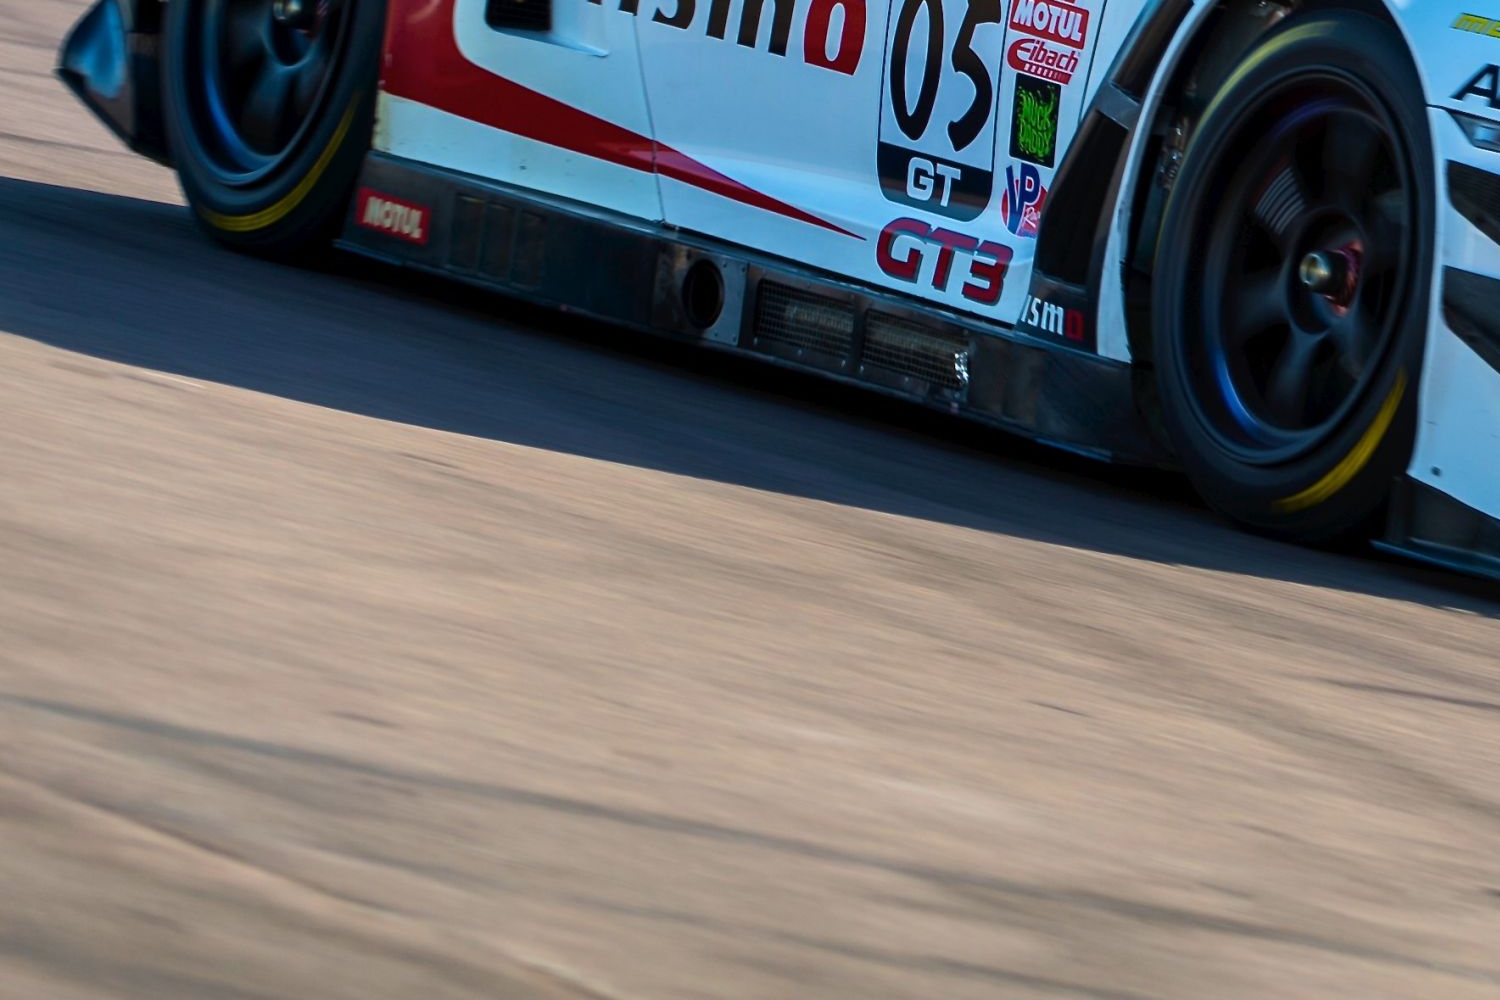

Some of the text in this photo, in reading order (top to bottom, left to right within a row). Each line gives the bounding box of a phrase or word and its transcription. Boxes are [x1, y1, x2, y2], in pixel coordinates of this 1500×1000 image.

[1007, 38, 1079, 73] Eibach
[906, 157, 961, 207] GT
[1006, 162, 1041, 236] VP
[363, 196, 422, 239] MOTUL
[876, 217, 1014, 306] GT3
